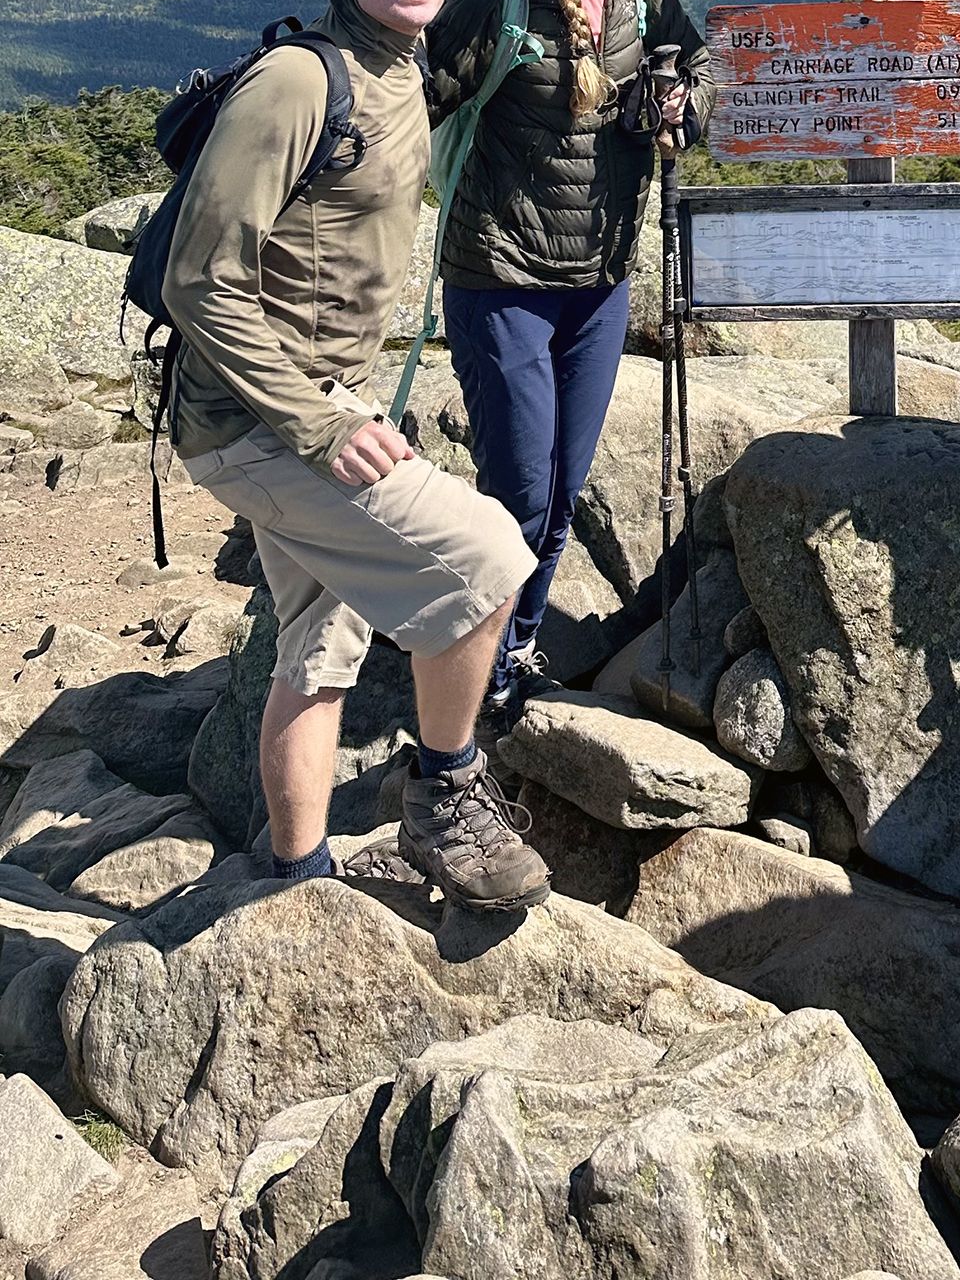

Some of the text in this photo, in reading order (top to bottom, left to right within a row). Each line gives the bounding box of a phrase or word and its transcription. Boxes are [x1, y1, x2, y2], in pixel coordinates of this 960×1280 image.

[731, 31, 776, 49] USFS
[770, 56, 856, 76] CARRIAGE
[867, 56, 914, 73] ROAD
[836, 86, 886, 103] TRAIL
[733, 117, 801, 136] BREEZY
[813, 114, 864, 133] POINT
